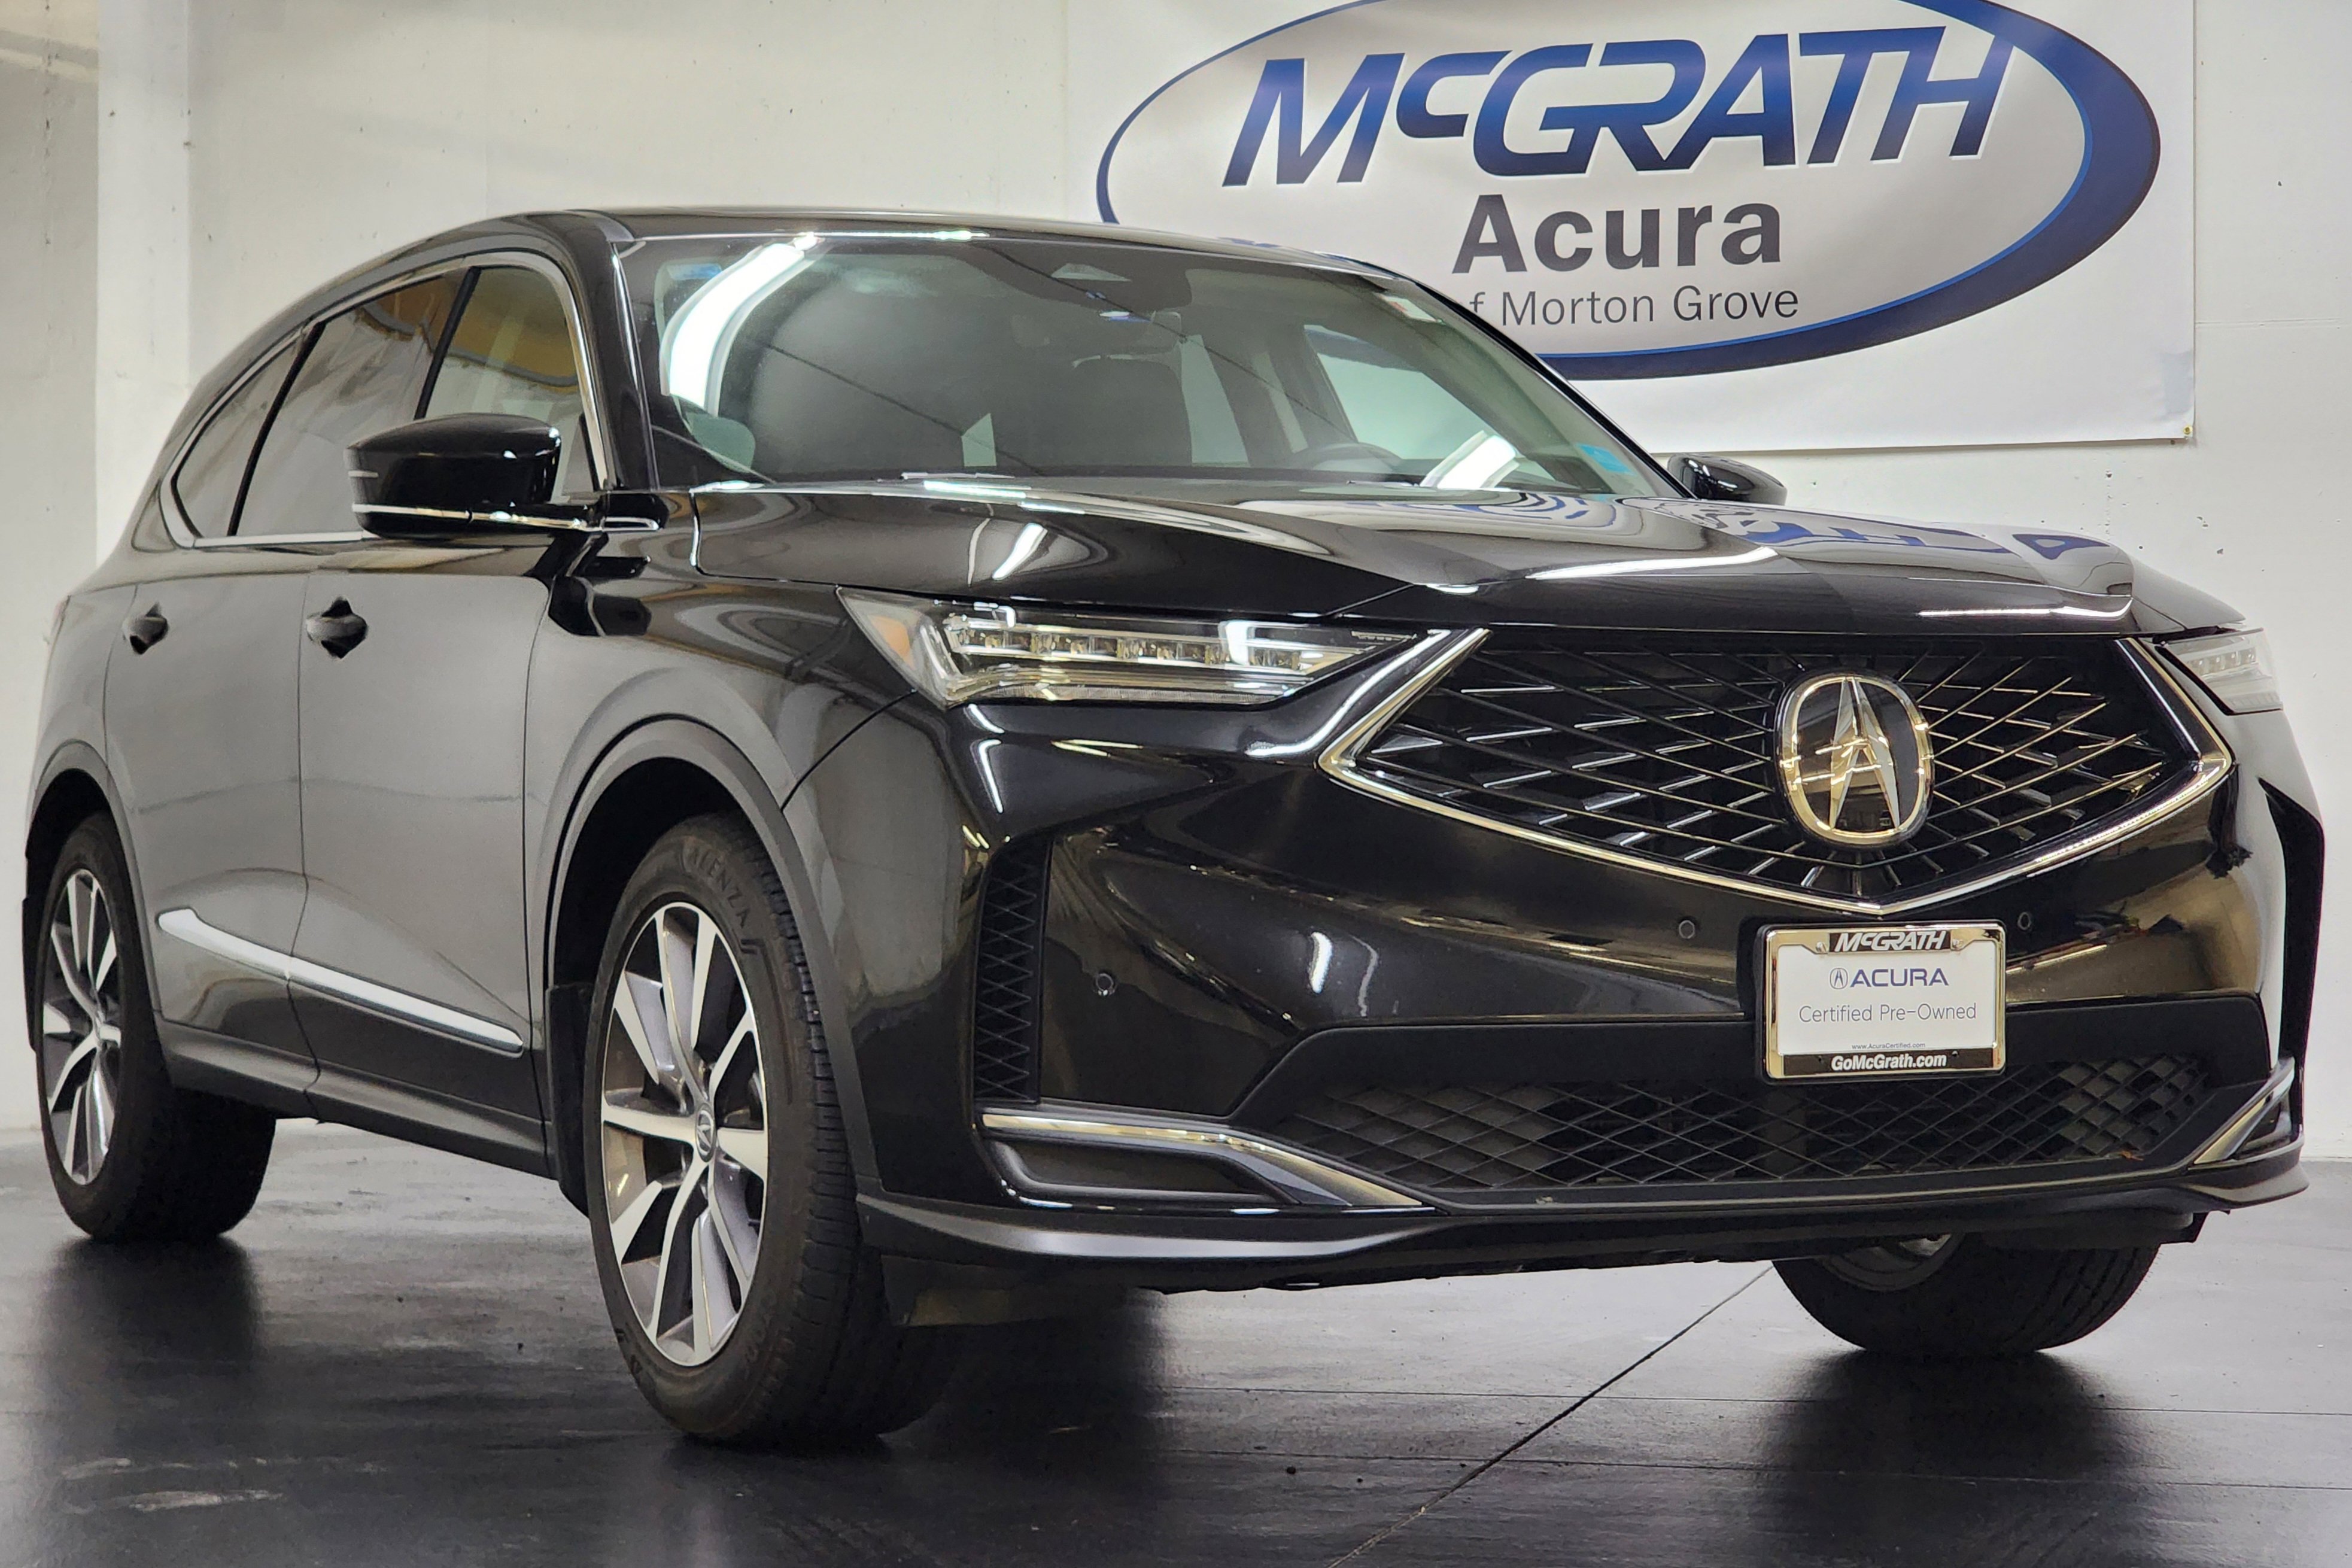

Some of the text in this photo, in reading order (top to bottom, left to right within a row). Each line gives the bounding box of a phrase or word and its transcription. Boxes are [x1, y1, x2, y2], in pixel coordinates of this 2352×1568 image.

[1452, 194, 1780, 274] Acura
[1502, 291, 1654, 326] Morton
[1673, 285, 1798, 321] Grove
[1850, 968, 1949, 987] ACURA
[1799, 1002, 1976, 1022] Certified Pre-Owned
[1831, 1053, 1947, 1071] GoMcGrath.com
